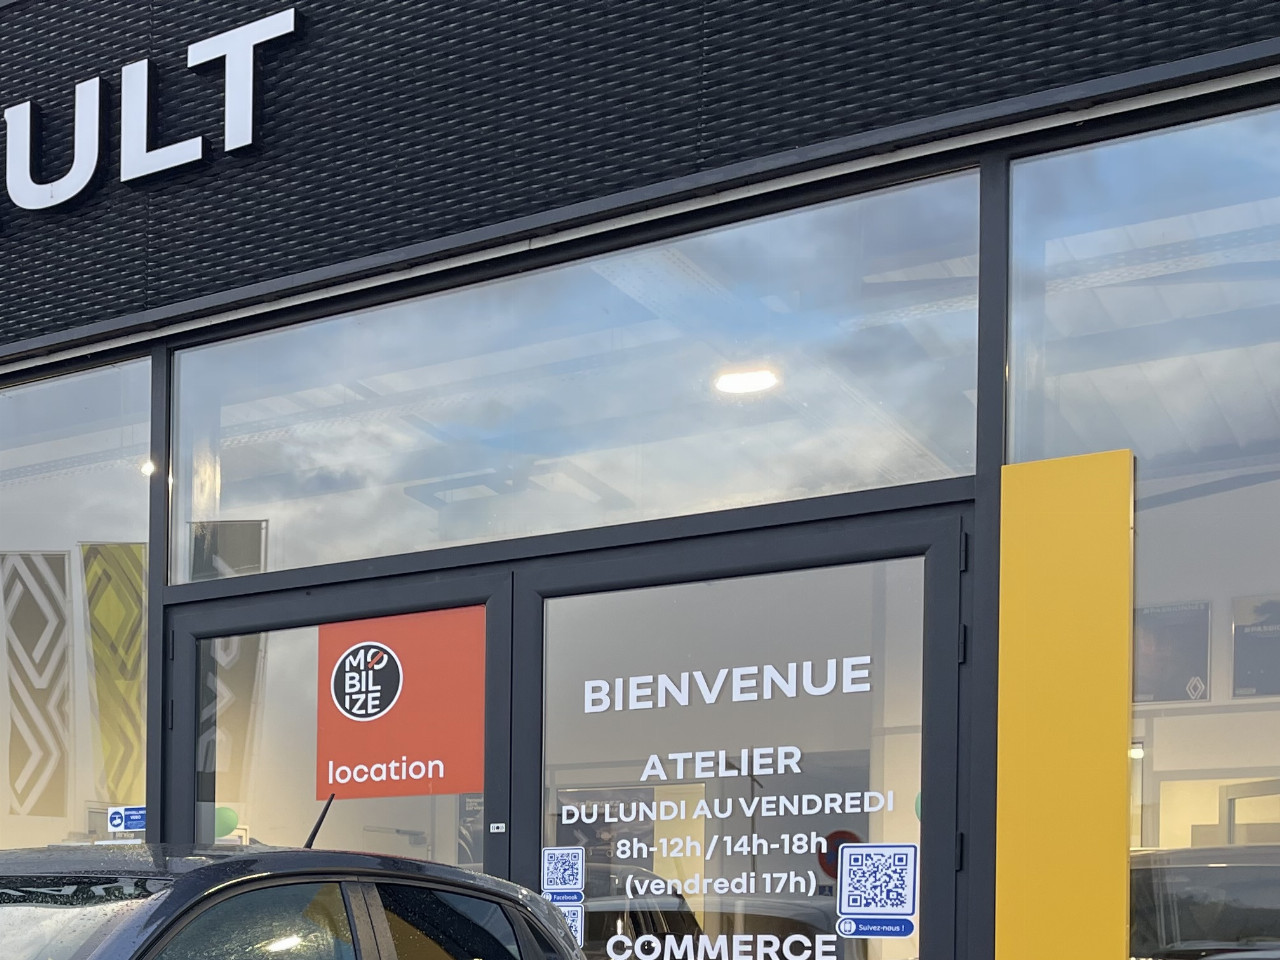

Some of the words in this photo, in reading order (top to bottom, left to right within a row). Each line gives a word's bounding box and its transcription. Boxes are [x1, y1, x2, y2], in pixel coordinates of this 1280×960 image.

[345, 670, 381, 694] BIL
[583, 655, 871, 714] BIENVENUE
[345, 692, 381, 715] IZE
[328, 755, 445, 785] location
[639, 745, 803, 782] ATELIER
[561, 804, 599, 825] DU
[604, 800, 686, 824] LUNDI
[692, 797, 733, 819] AU
[739, 790, 894, 818] VENDREDI
[625, 871, 756, 899] (vendredi
[761, 870, 817, 897] 17h)
[858, 924, 900, 932] Suivez-nous
